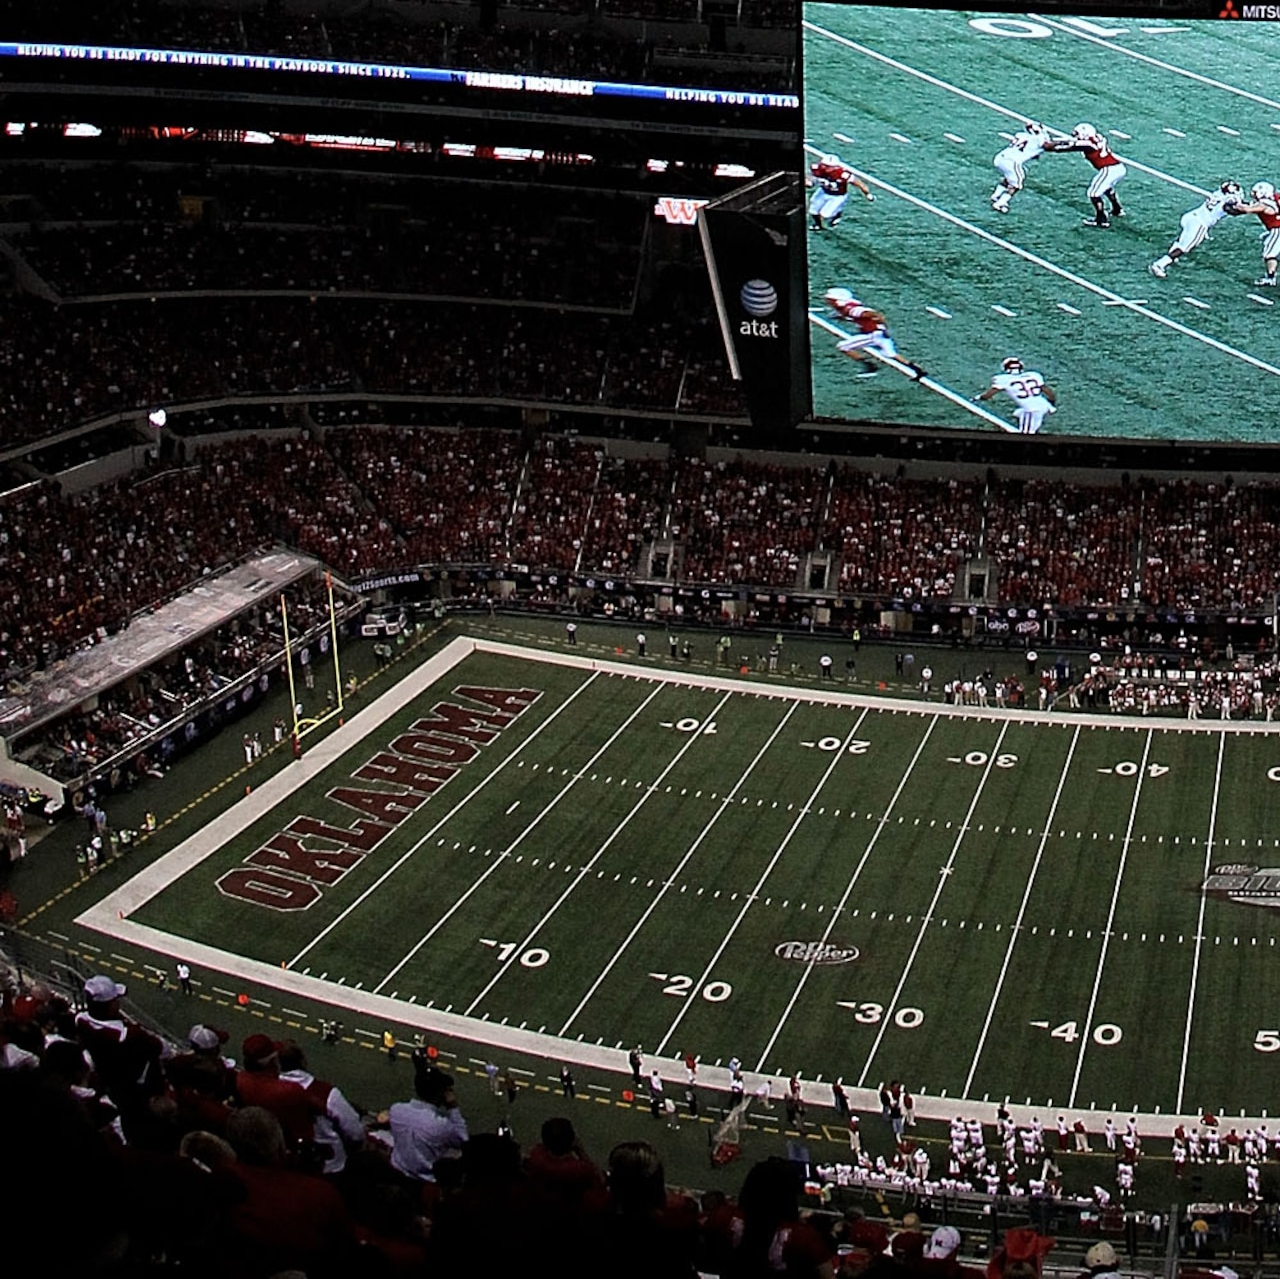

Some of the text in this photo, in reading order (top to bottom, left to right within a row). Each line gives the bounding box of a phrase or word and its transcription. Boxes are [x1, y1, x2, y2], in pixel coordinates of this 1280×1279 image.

[64, 46, 87, 58] YOU
[90, 47, 103, 59] BE
[170, 51, 228, 66] ANYTHING
[232, 55, 246, 66] IN
[274, 58, 334, 73] PLAYBOOK
[338, 62, 373, 76] SINCE
[466, 72, 594, 95] FARMERS INSURANCE
[666, 89, 717, 103] HELPING
[721, 91, 744, 104] YOU
[750, 93, 763, 106] BE
[740, 319, 779, 338] at&t
[1010, 379, 1041, 399] 32
[675, 717, 718, 735] 10
[818, 737, 871, 755] 20
[960, 751, 1019, 769] 30
[1115, 761, 1170, 777] 40
[214, 685, 545, 912] OKLAHOMA
[496, 943, 550, 967] 10
[663, 975, 733, 1002] 20
[854, 1003, 925, 1028] 30
[1050, 1020, 1123, 1045] 40
